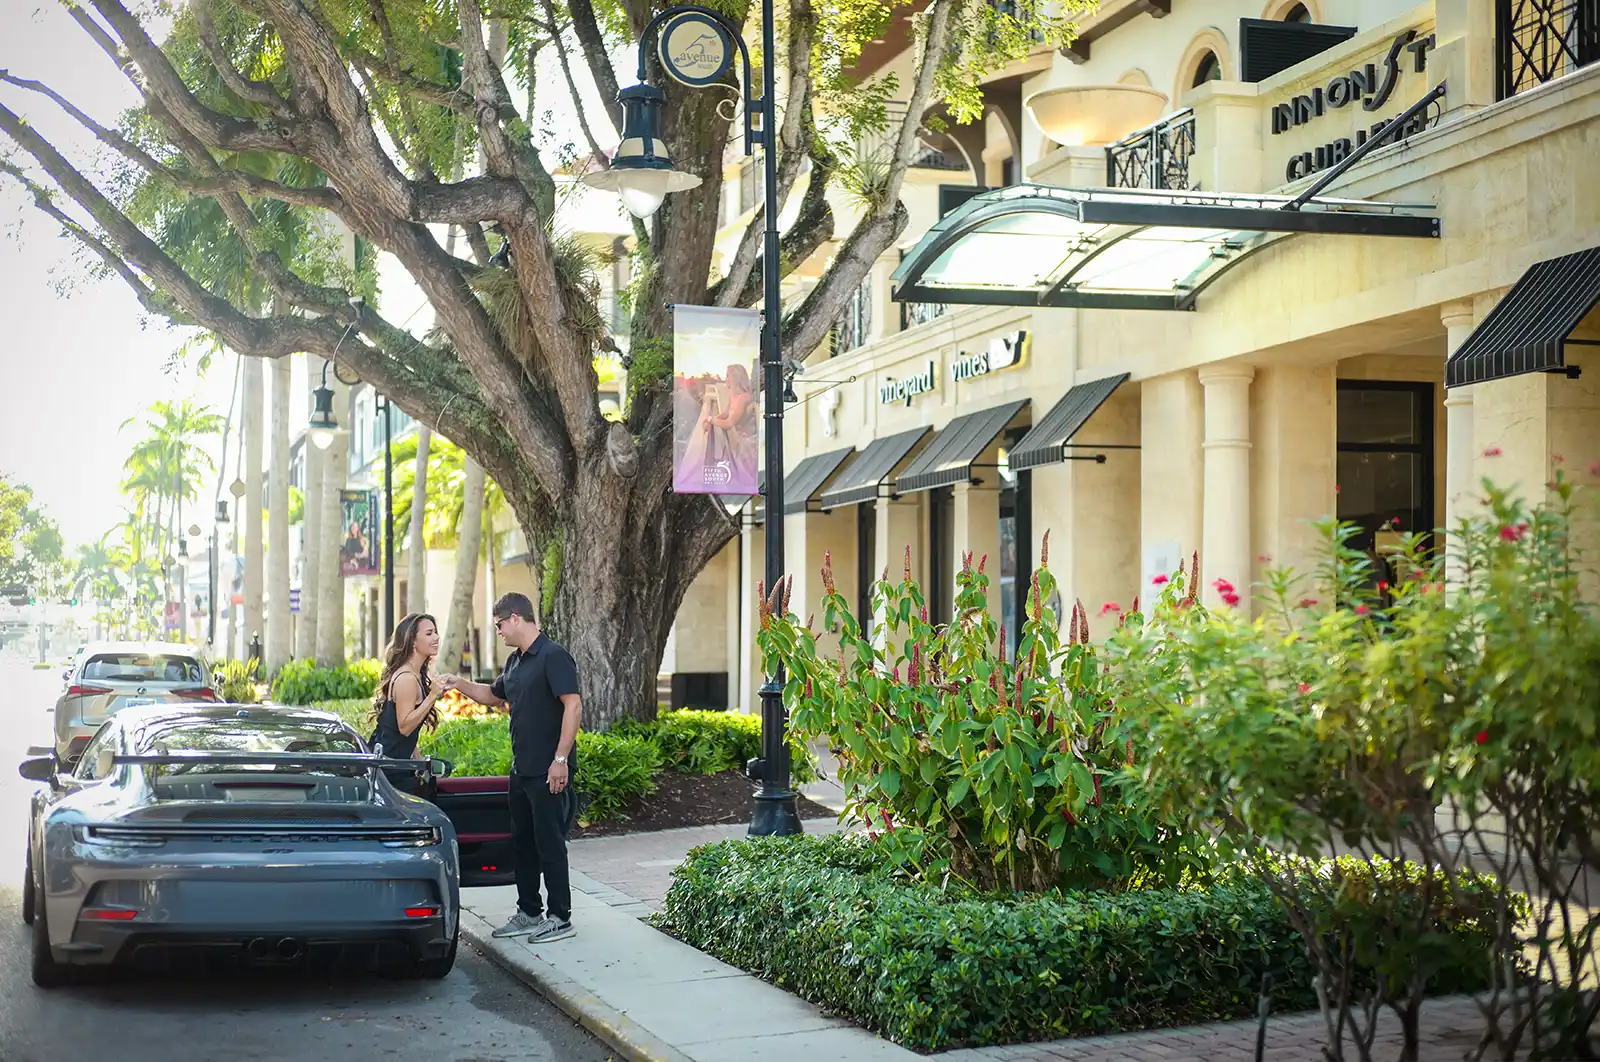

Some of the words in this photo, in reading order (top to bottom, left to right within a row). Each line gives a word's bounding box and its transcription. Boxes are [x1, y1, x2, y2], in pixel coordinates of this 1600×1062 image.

[680, 52, 720, 63] avenue
[1271, 87, 1323, 135] INN
[1325, 63, 1376, 109] ON
[1285, 137, 1351, 183] CLUB
[879, 360, 935, 407] vineyard
[950, 350, 990, 382] vines
